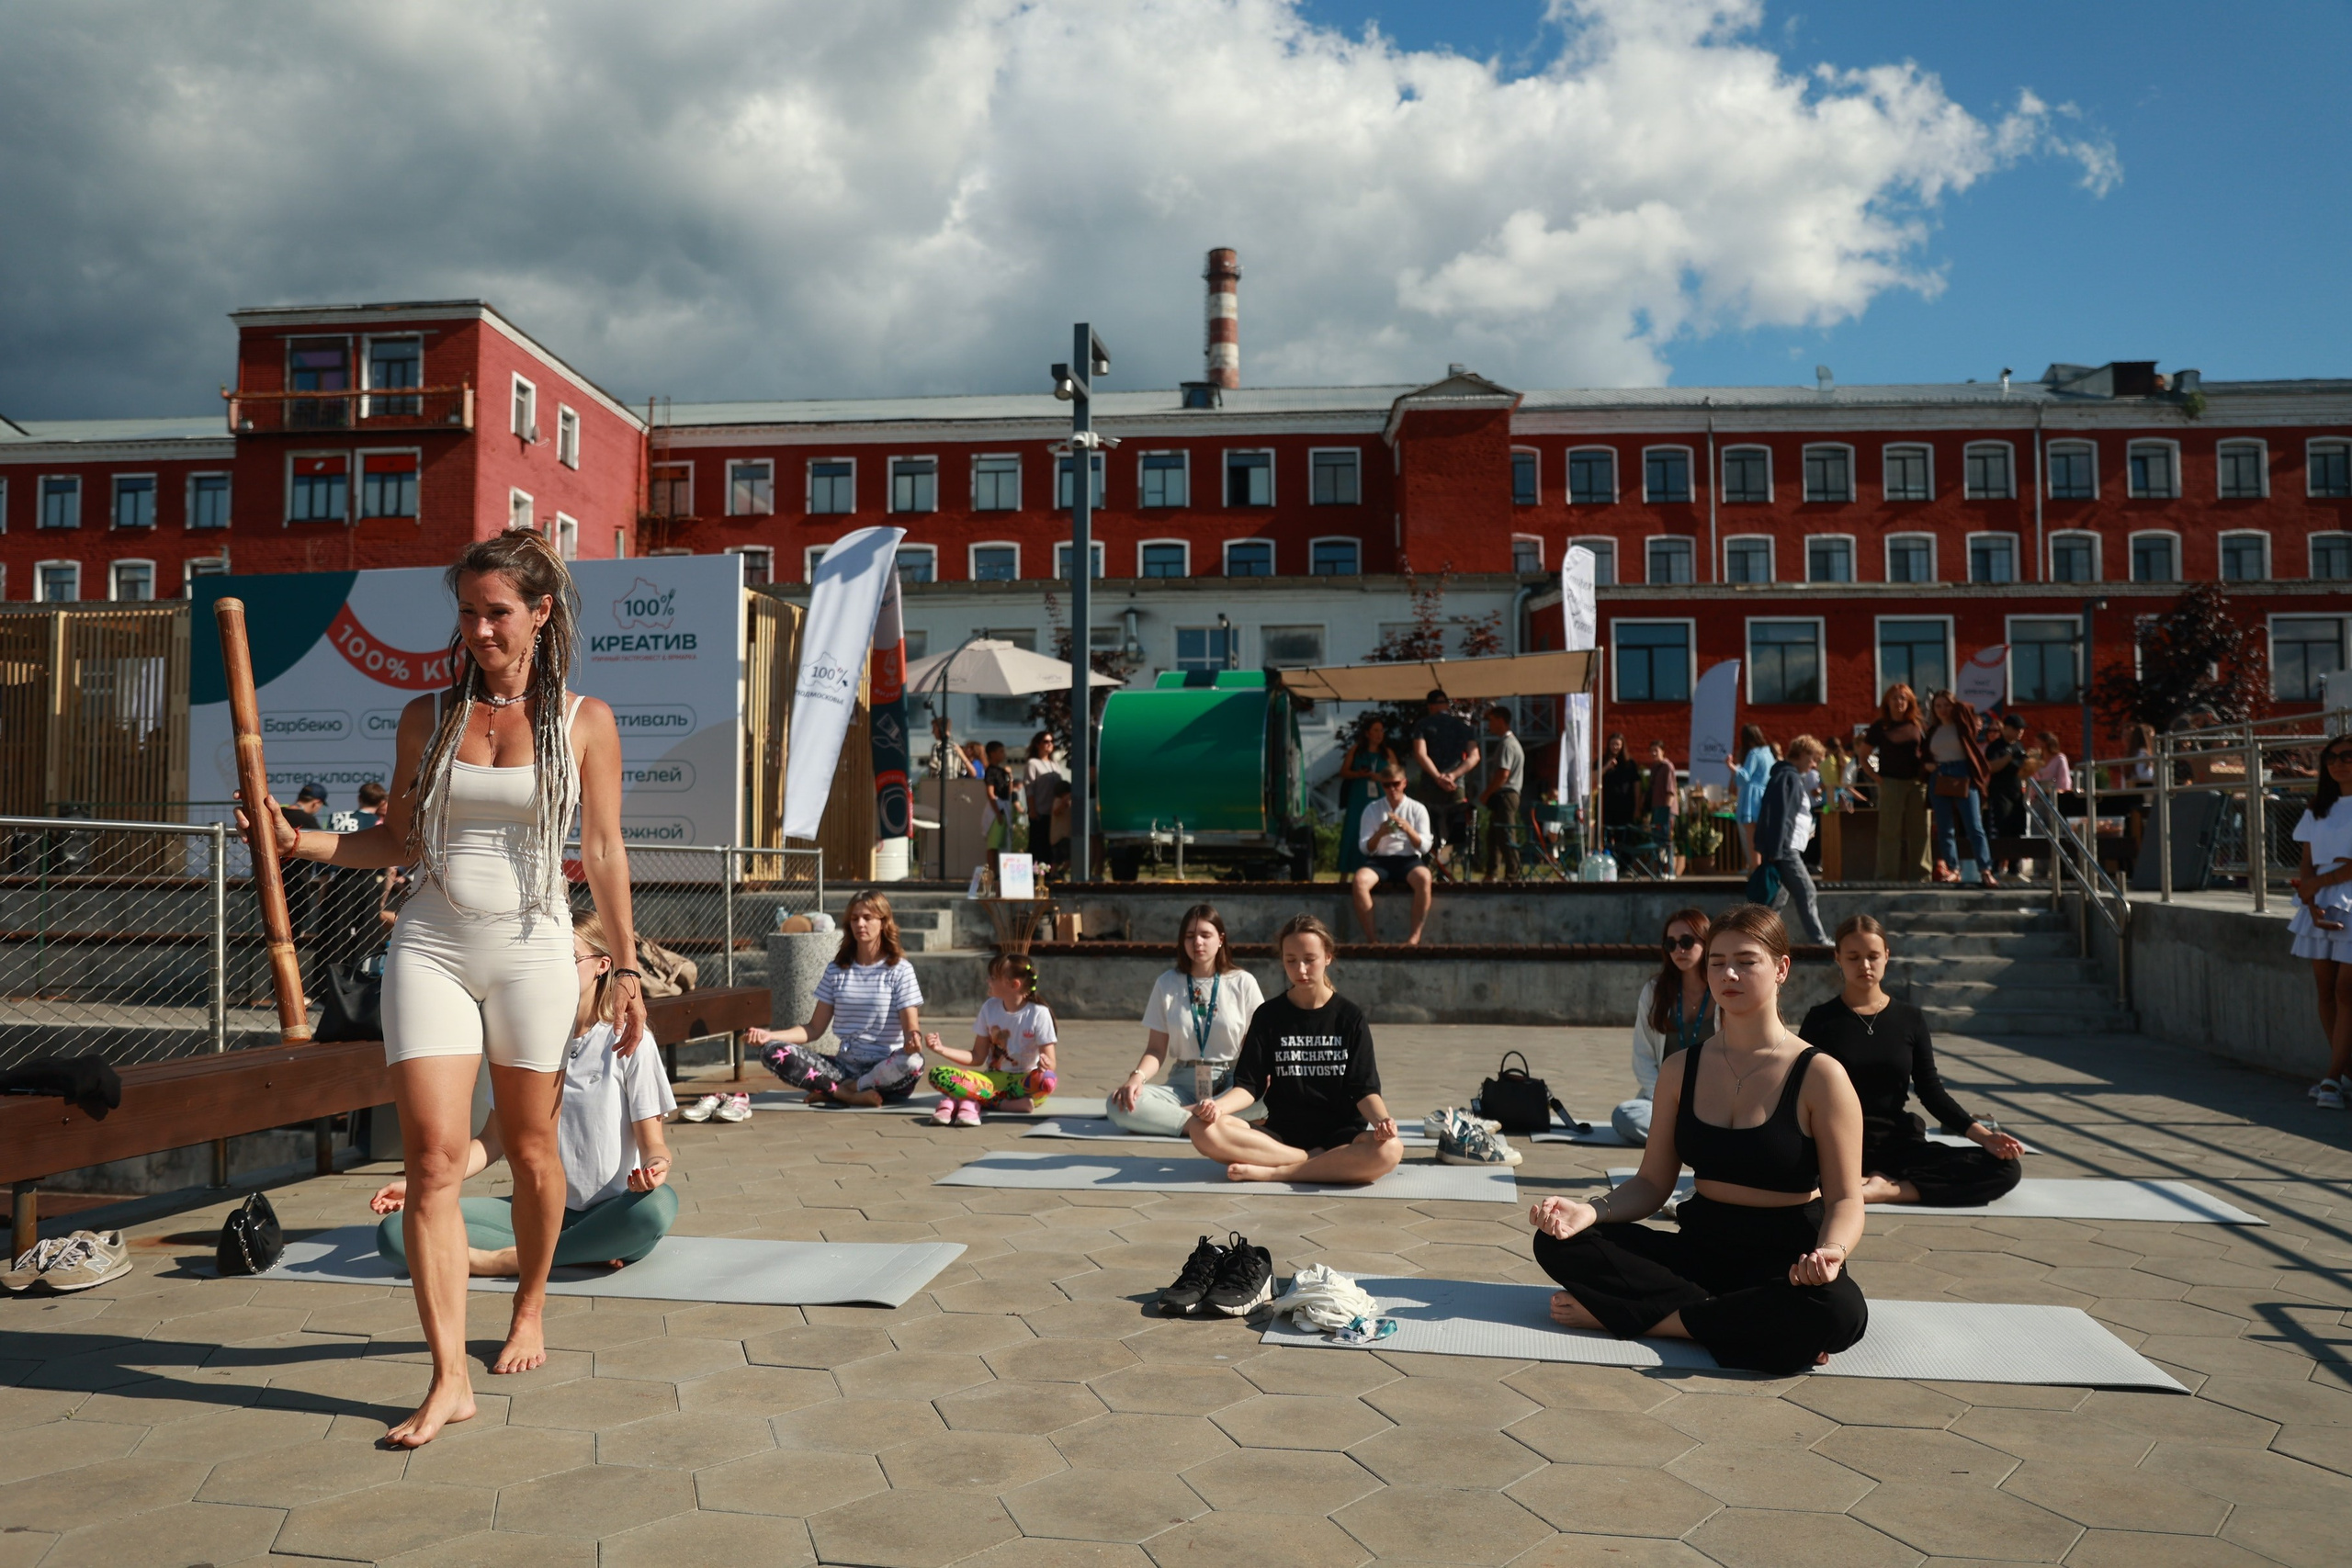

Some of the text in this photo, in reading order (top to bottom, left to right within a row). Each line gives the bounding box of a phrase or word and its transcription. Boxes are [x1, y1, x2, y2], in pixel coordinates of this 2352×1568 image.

[625, 589, 675, 616] 100%
[591, 634, 697, 652] КРЕАТИВ
[338, 625, 410, 681] 100%
[264, 717, 343, 734] Барбекю
[266, 772, 385, 784] астер-классы
[1280, 1035, 1342, 1047] SAKHALIN
[1274, 1049, 1349, 1062] KAMCHATKA
[1275, 1064, 1346, 1077] VLADIVOSTO
